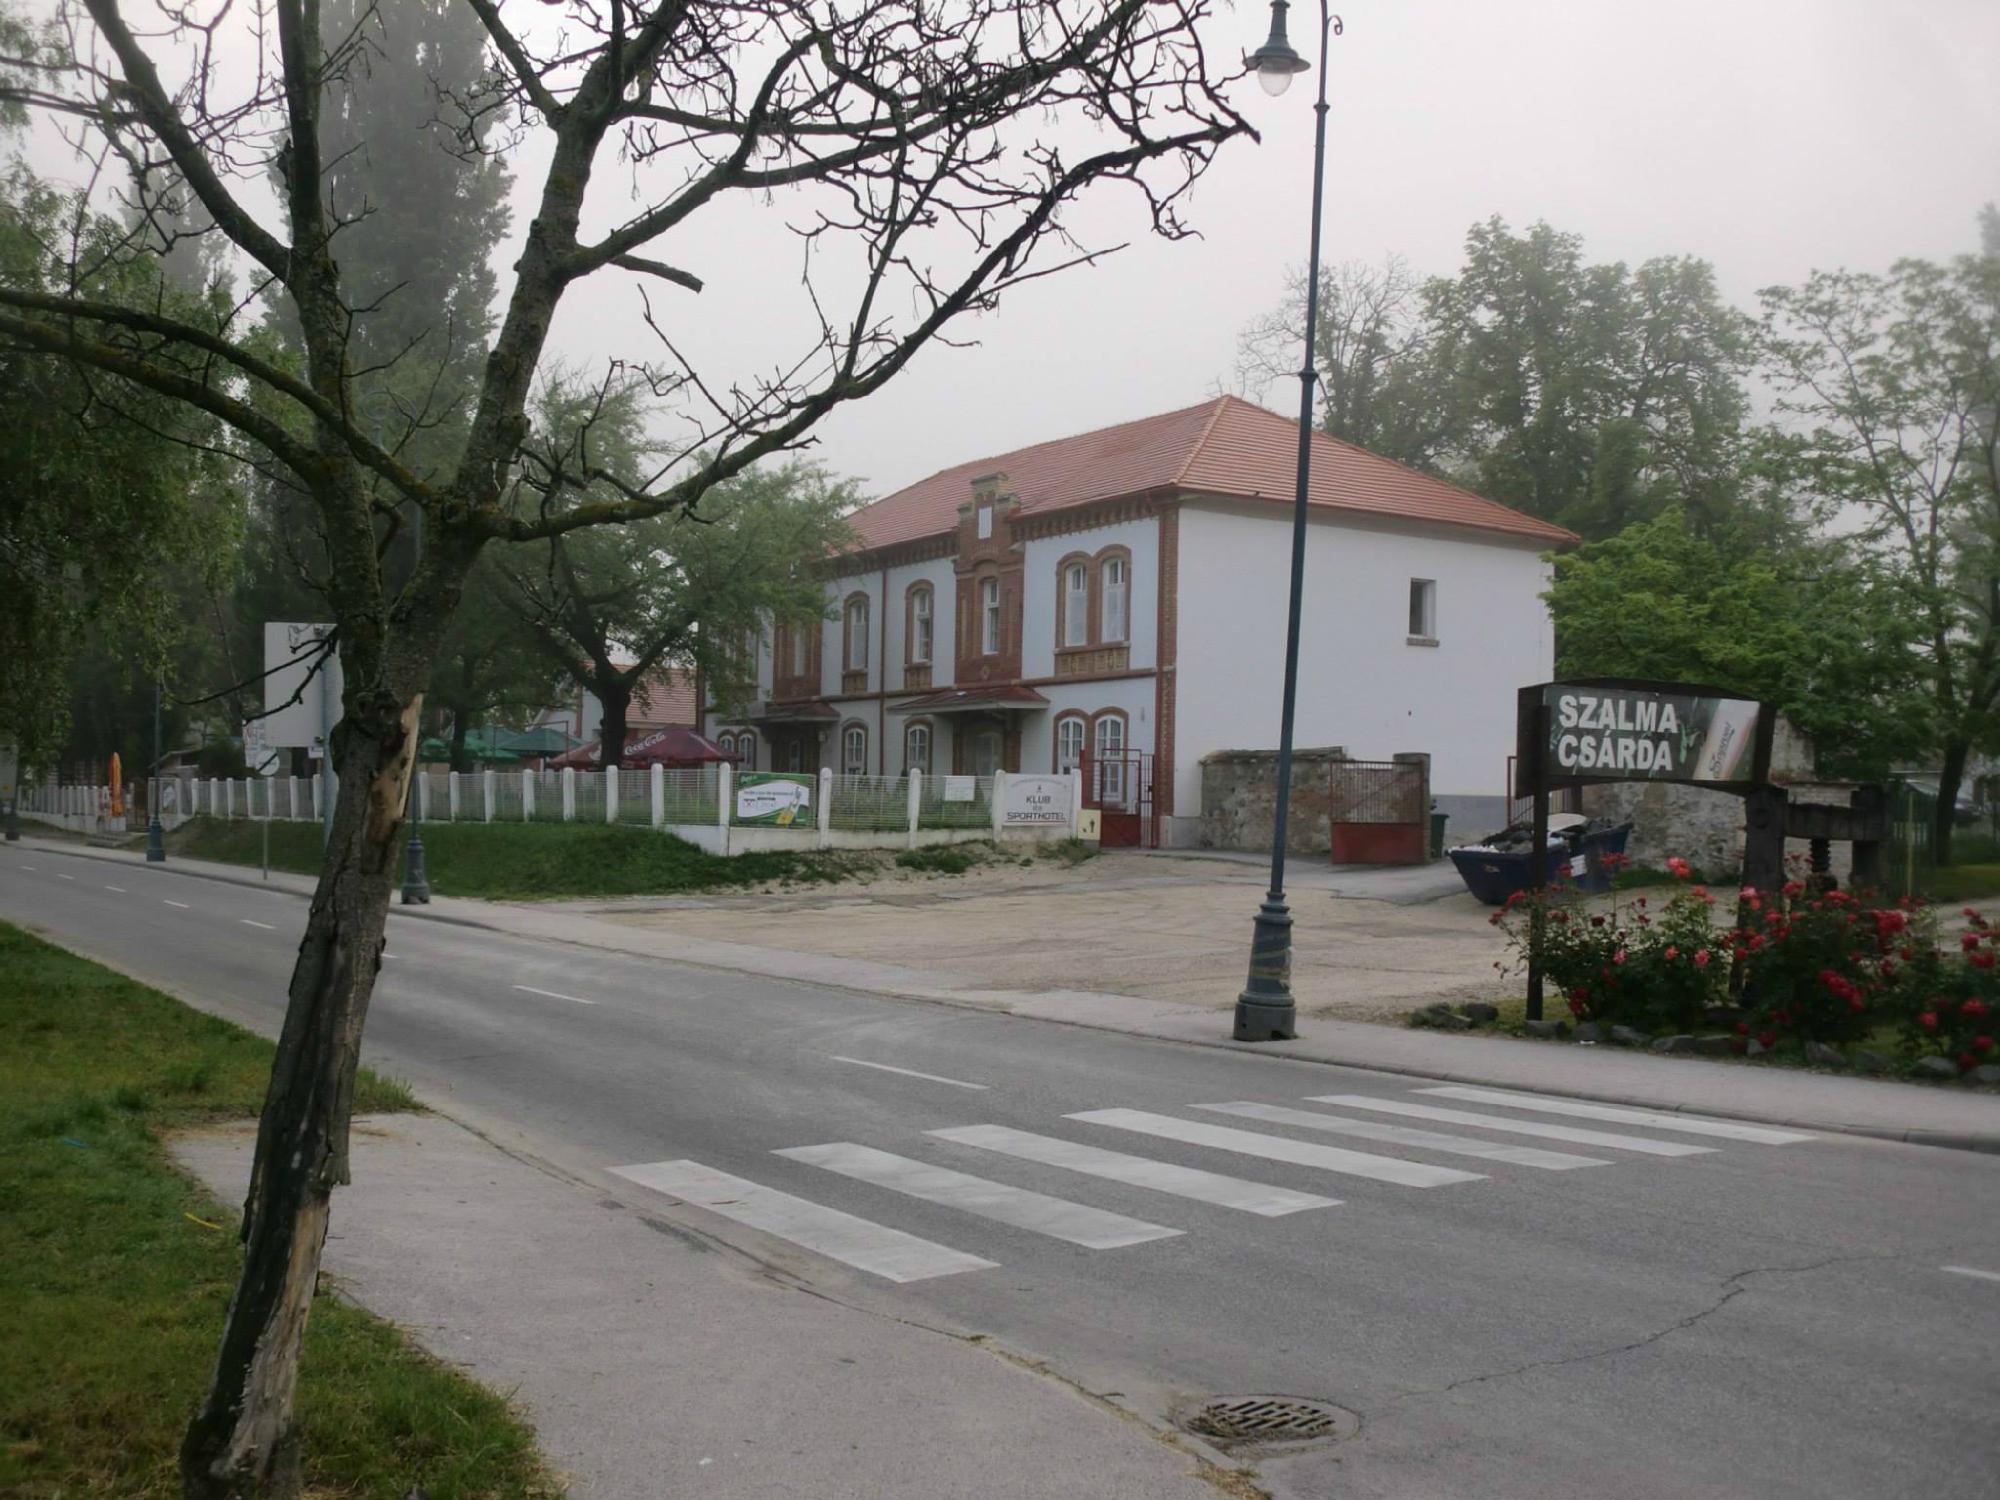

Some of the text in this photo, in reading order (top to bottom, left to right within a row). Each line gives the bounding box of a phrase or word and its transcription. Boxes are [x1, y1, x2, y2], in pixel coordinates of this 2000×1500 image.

[1559, 695, 1678, 734] SZALMA
[1558, 731, 1672, 771] CSÁRDA
[1026, 795, 1051, 804] KLUB
[1007, 812, 1066, 820] SPORTHOTEL
